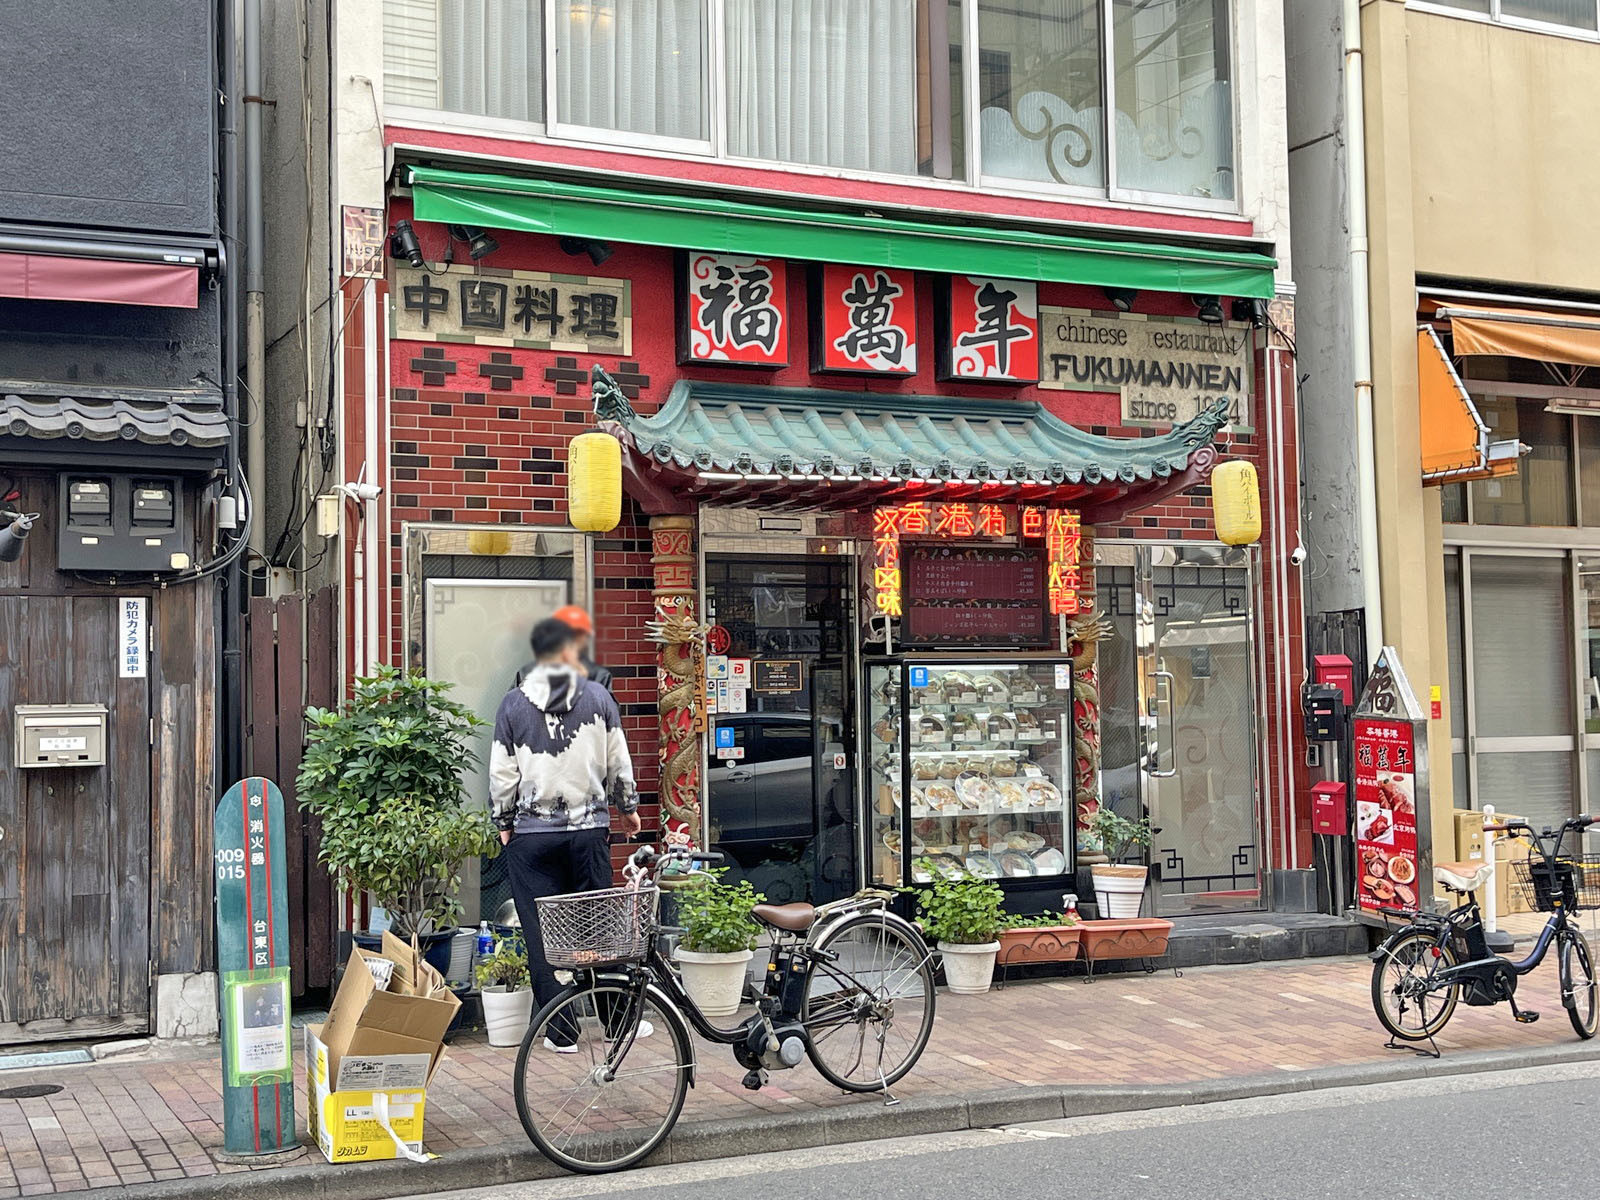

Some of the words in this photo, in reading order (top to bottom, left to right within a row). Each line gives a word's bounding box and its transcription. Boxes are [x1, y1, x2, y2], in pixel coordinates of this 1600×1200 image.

[403, 274, 619, 340] 中国料理
[1057, 317, 1128, 345] chinese
[1050, 353, 1241, 392] FUKUMANNEN
[1130, 393, 1177, 420] since
[899, 502, 1043, 538] 香港特色
[126, 601, 139, 675] 防犯カメラ録画中
[1358, 744, 1410, 774] 福萬年
[250, 819, 265, 866] 消火器
[218, 865, 246, 879] 015
[253, 919, 268, 966] 台東区
[346, 1109, 357, 1117] LL
